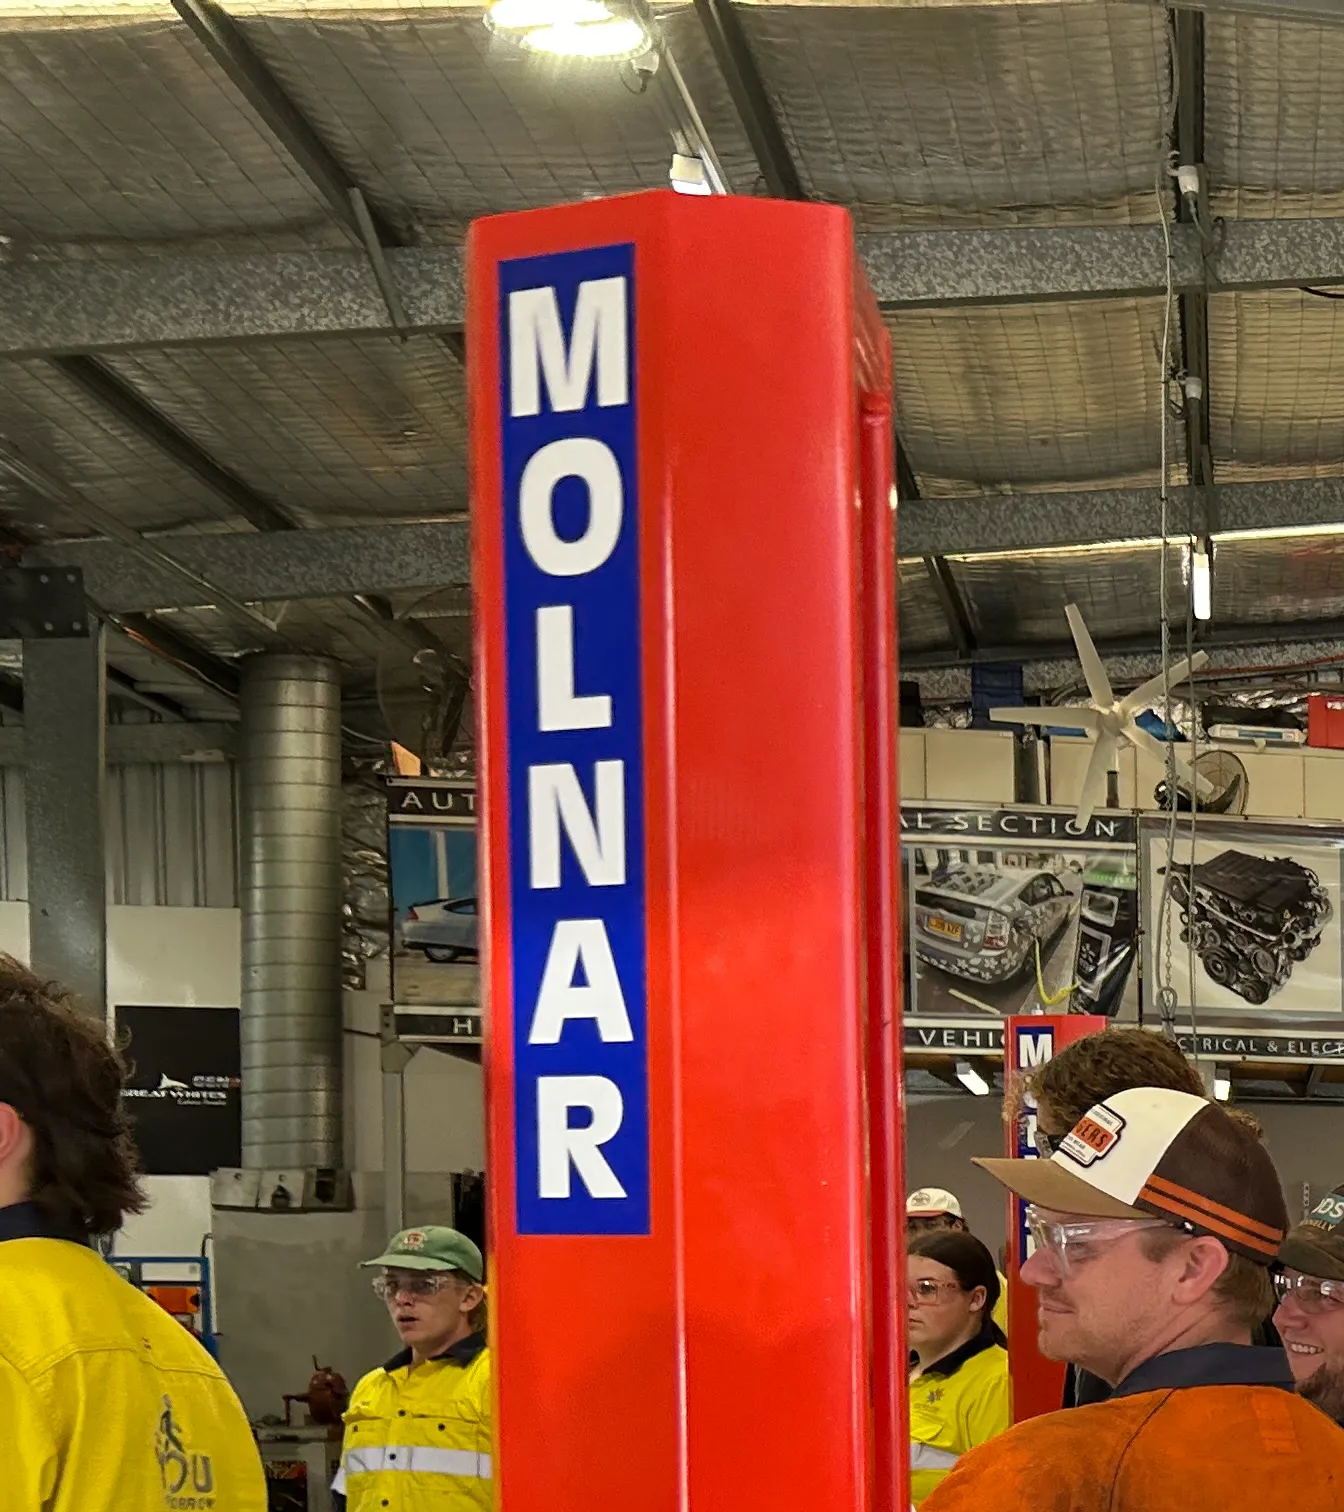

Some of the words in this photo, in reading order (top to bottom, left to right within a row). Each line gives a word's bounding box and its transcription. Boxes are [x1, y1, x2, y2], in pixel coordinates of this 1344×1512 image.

[507, 274, 635, 1201] MOLNAR
[953, 815, 1115, 837] SECTION
[918, 1029, 1004, 1047] VEHI
[1266, 1040, 1279, 1053] &
